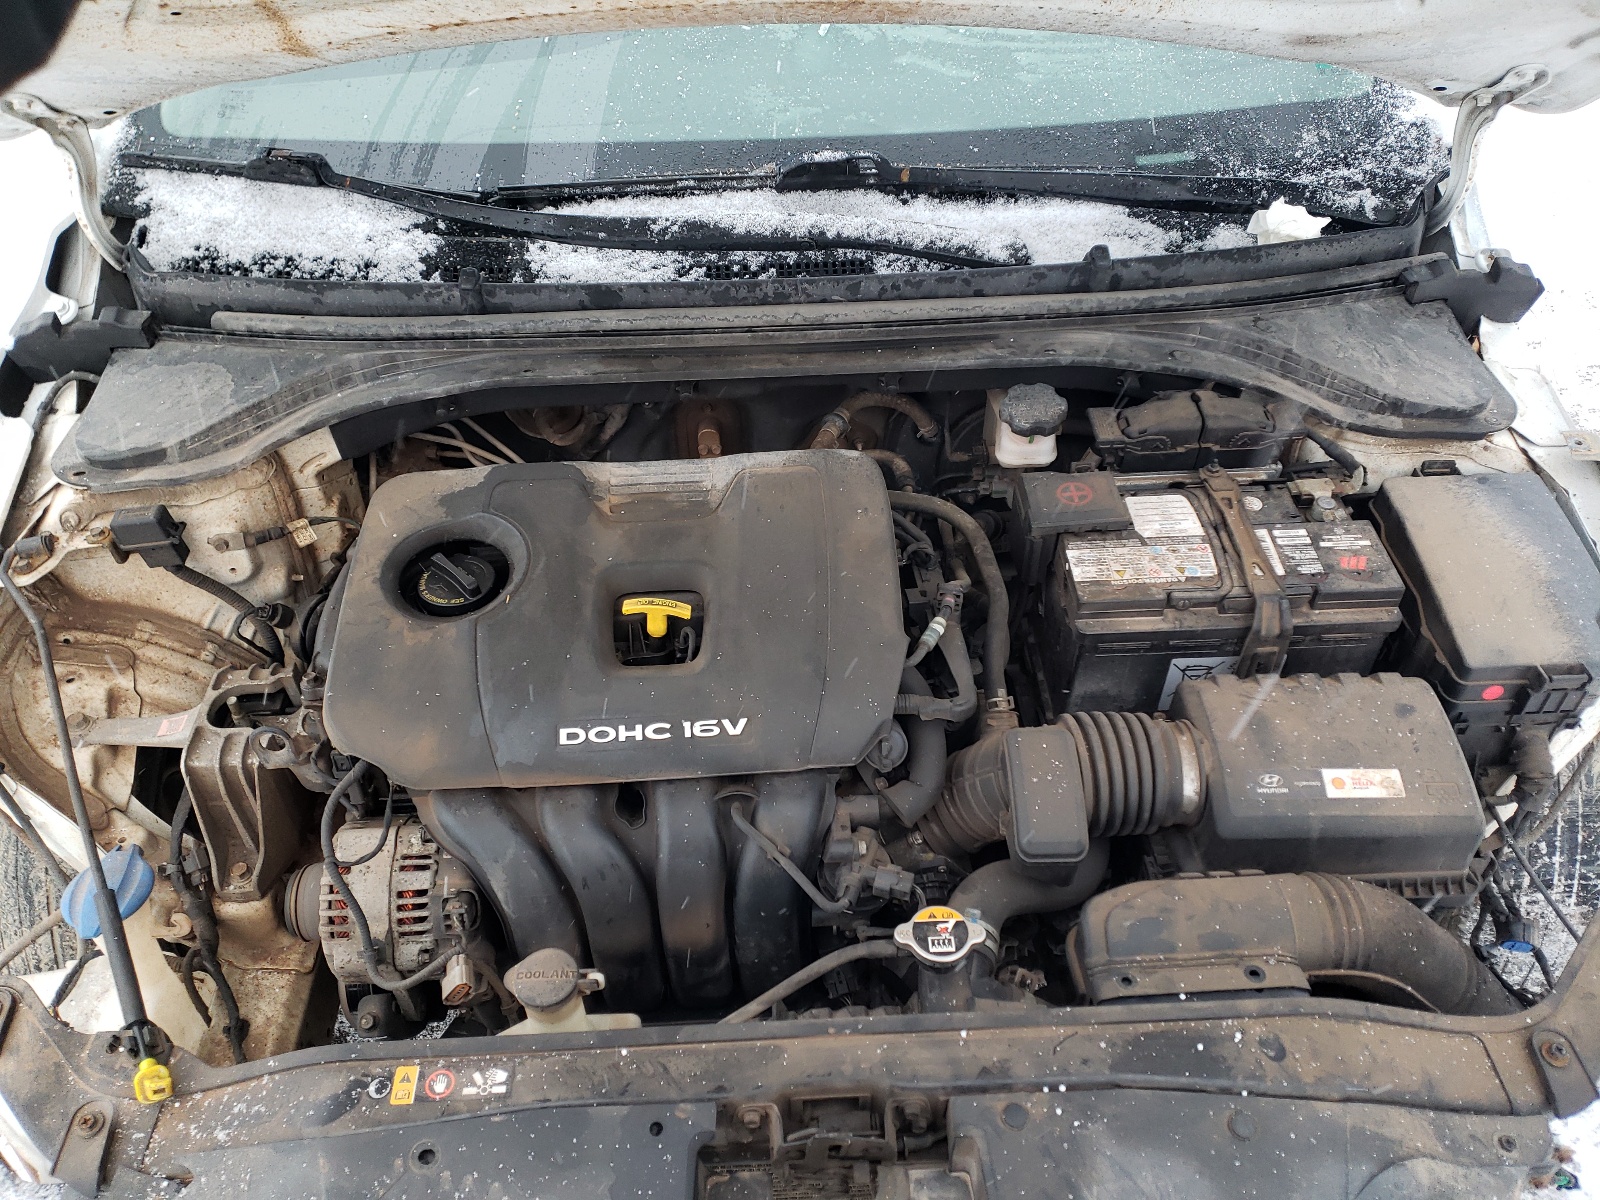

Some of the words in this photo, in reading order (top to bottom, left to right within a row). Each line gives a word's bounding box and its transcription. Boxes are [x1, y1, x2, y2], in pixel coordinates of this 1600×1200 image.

[558, 723, 672, 746] DOHC
[682, 717, 749, 739] 16V
[516, 970, 578, 980] COOLANT
